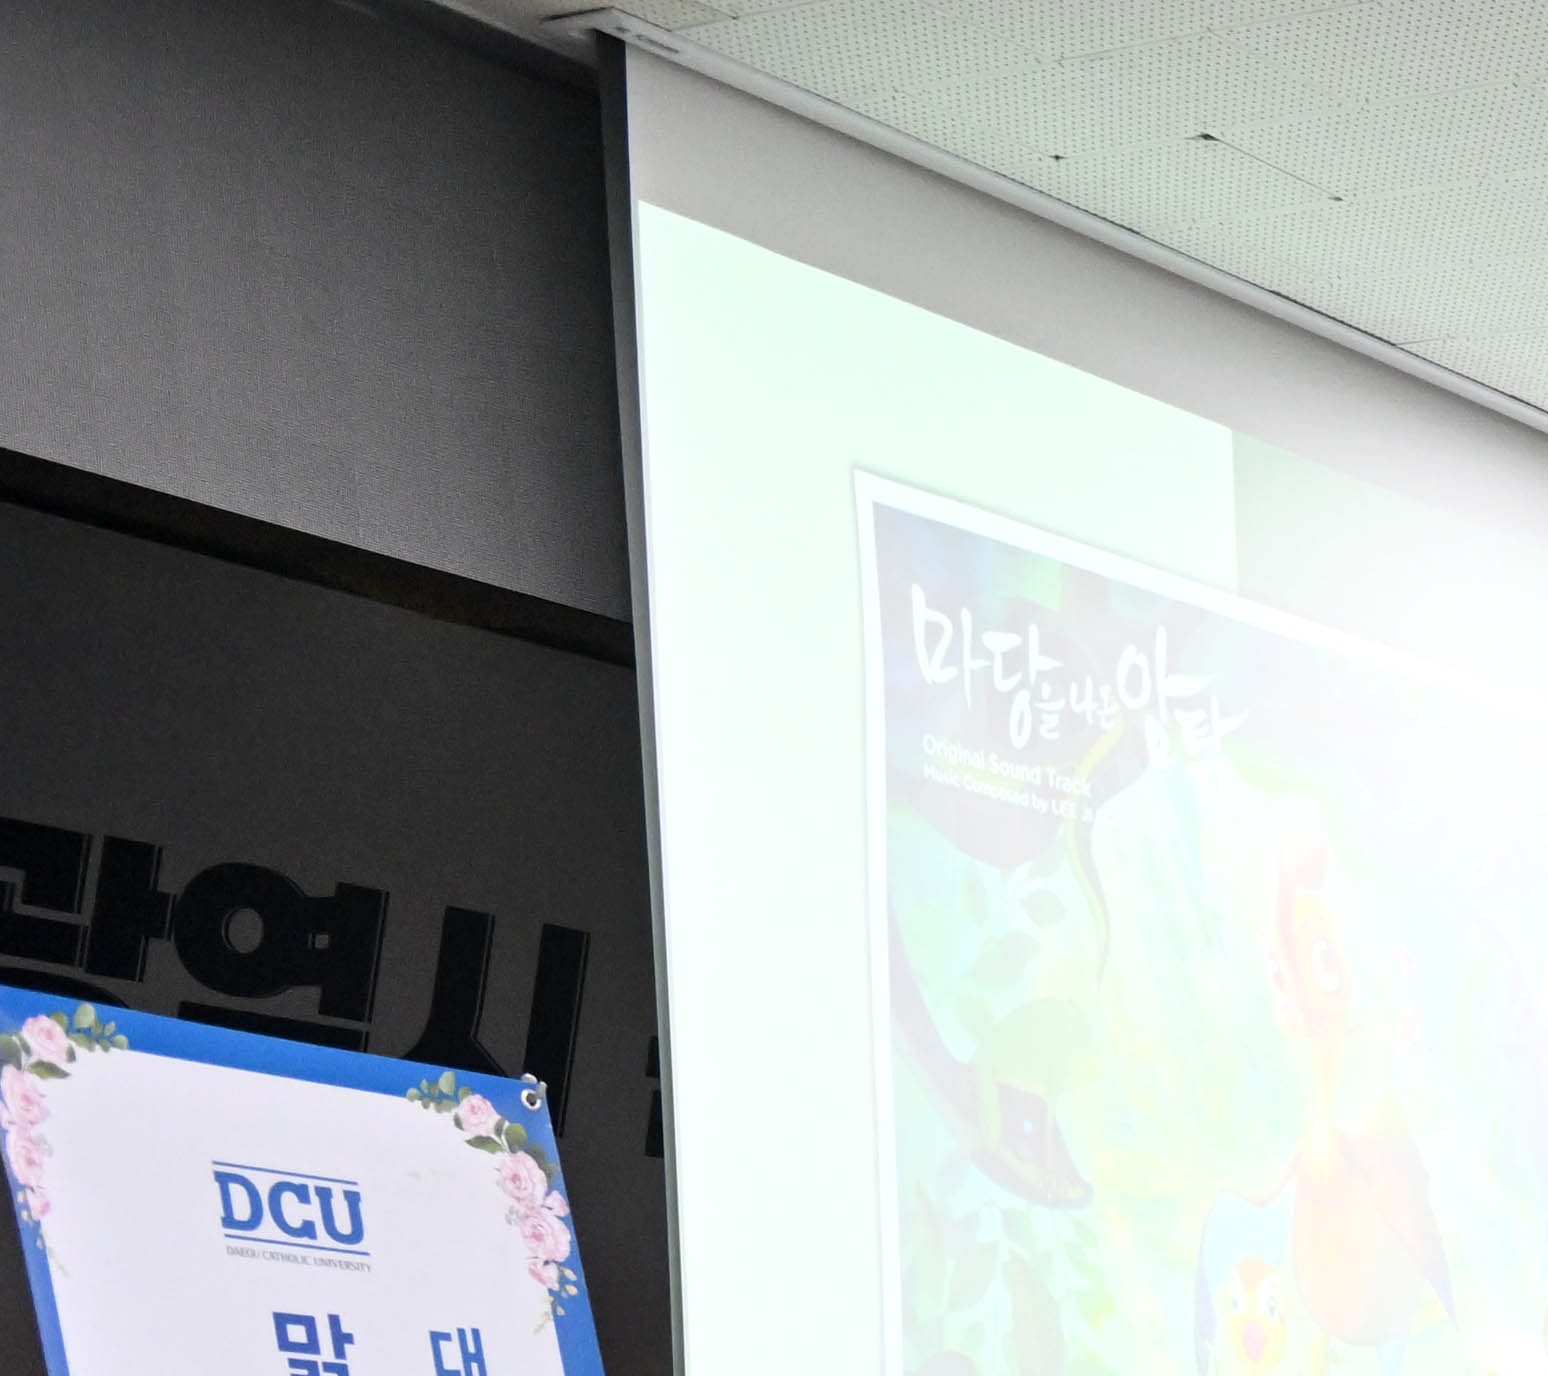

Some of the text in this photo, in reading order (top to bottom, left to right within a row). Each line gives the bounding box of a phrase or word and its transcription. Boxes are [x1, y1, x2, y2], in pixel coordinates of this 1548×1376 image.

[923, 733, 1093, 799] Original Sound Track
[213, 1170, 365, 1246] DCU
[226, 1245, 372, 1273] DAEGU CATHOLIC UNIVERSITY
